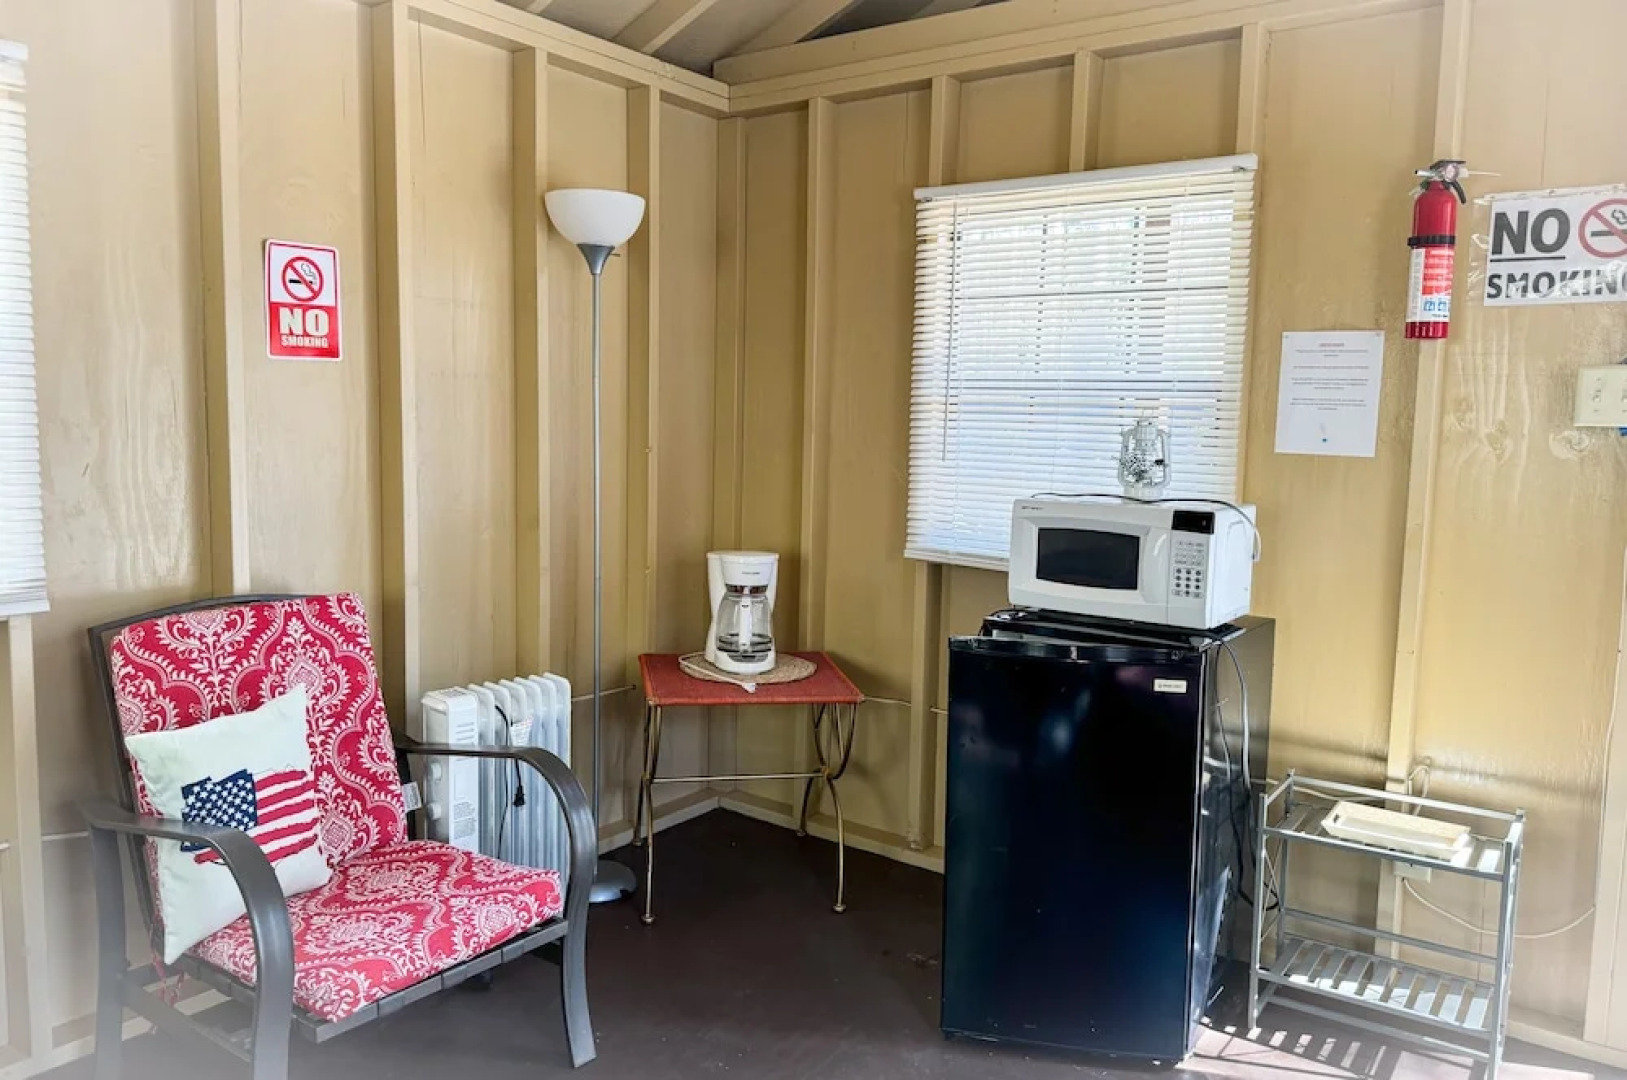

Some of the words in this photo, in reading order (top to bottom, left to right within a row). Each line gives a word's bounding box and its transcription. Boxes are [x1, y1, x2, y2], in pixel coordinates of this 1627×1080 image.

[1492, 208, 1571, 254] NO
[1486, 268, 1627, 298] SMOKIN
[280, 307, 329, 336] NO
[281, 335, 328, 349] SMOKING
